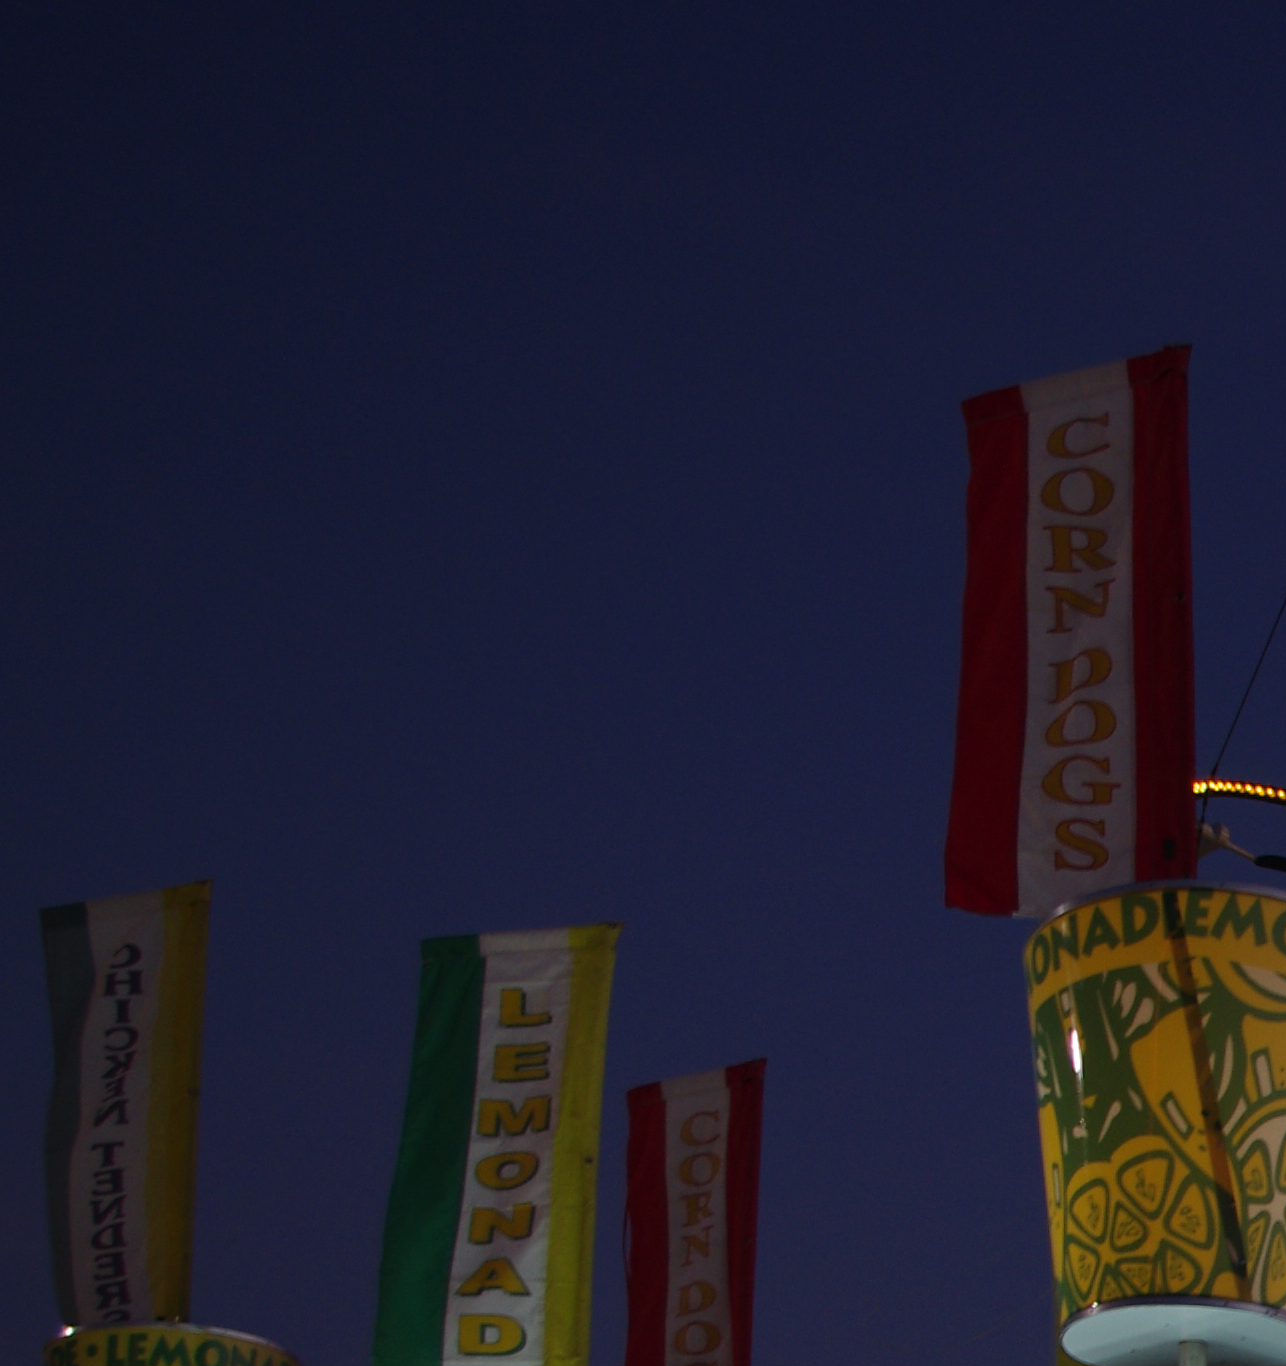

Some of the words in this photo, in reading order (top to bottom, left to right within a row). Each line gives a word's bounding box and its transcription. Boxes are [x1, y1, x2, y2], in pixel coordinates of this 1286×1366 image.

[1041, 413, 1117, 634] CORN
[1041, 647, 1121, 871] DOGS
[678, 1110, 722, 1268] CORN
